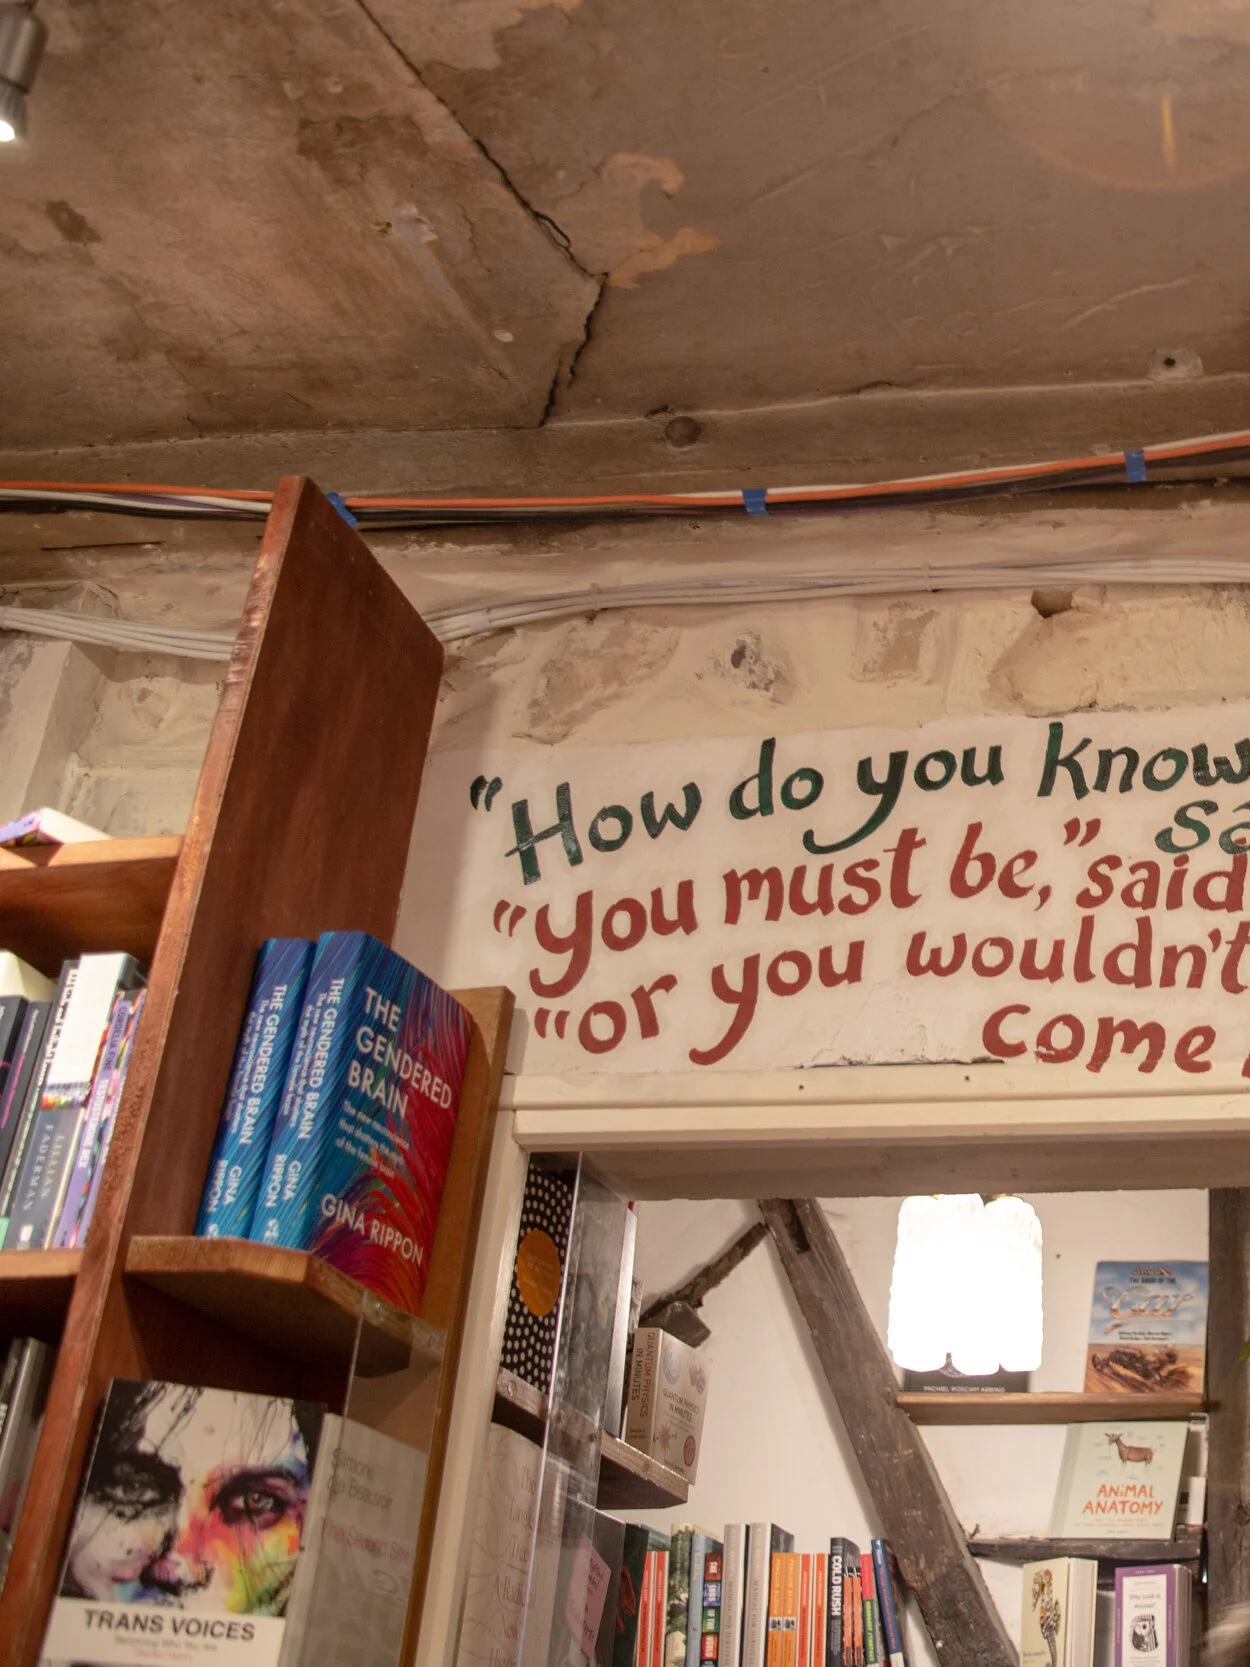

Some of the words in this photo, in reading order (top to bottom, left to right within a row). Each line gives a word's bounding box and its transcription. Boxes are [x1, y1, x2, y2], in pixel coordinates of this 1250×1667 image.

[729, 737, 824, 820] do
[802, 744, 1004, 855] you
[723, 827, 927, 925] must
[1076, 837, 1249, 913] said
[269, 984, 288, 1011] THE
[326, 977, 346, 1005] THE
[365, 985, 401, 1032] THE
[689, 940, 865, 1065] you
[251, 1014, 280, 1094] GENDERED
[308, 1008, 338, 1088] GENDERED
[982, 1003, 1216, 1074] come
[348, 1060, 409, 1119] BRAIN
[356, 1025, 452, 1109] GENDERED
[239, 1097, 262, 1144] BRAIN
[297, 1092, 321, 1139] BRAIN
[23, 1124, 54, 1211] FADERMAN
[40, 1135, 65, 1199] LILLIAN
[206, 1159, 229, 1213] RIPPON
[223, 1165, 243, 1206] GINA
[264, 1154, 287, 1208] RIPPON
[282, 1160, 302, 1201] GINA
[321, 1193, 366, 1236] GINA
[370, 1219, 424, 1267] RIPPON
[635, 1347, 643, 1359] IN
[642, 1331, 655, 1377] QUANTUM
[631, 1361, 643, 1401] MINUTES
[639, 1379, 652, 1418] PHYSICS
[1081, 1500, 1164, 1515] ANATOMY
[709, 1561, 718, 1573] THE
[832, 1555, 843, 1584] COLD
[84, 1608, 164, 1634] TRANS
[172, 1618, 257, 1641] VOICES
[831, 1586, 842, 1617] RUSH
